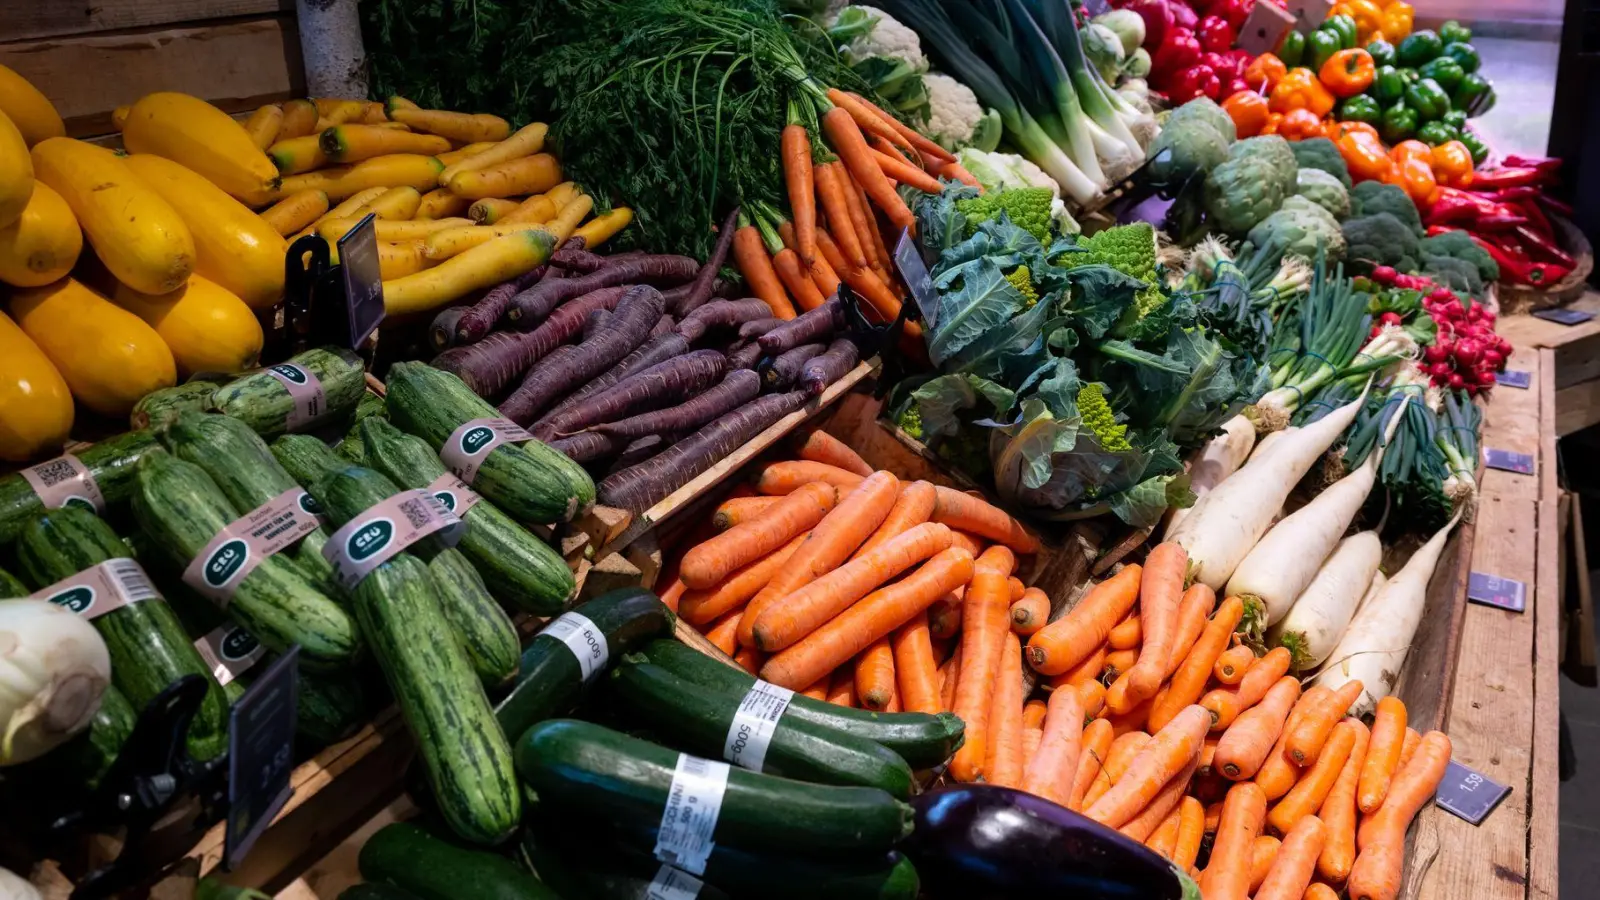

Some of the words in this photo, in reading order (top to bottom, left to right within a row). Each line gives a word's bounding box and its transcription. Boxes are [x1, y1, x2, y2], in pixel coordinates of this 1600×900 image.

[583, 629, 602, 659] 500g
[731, 723, 751, 754] 500g
[1459, 773, 1484, 792] 1.59
